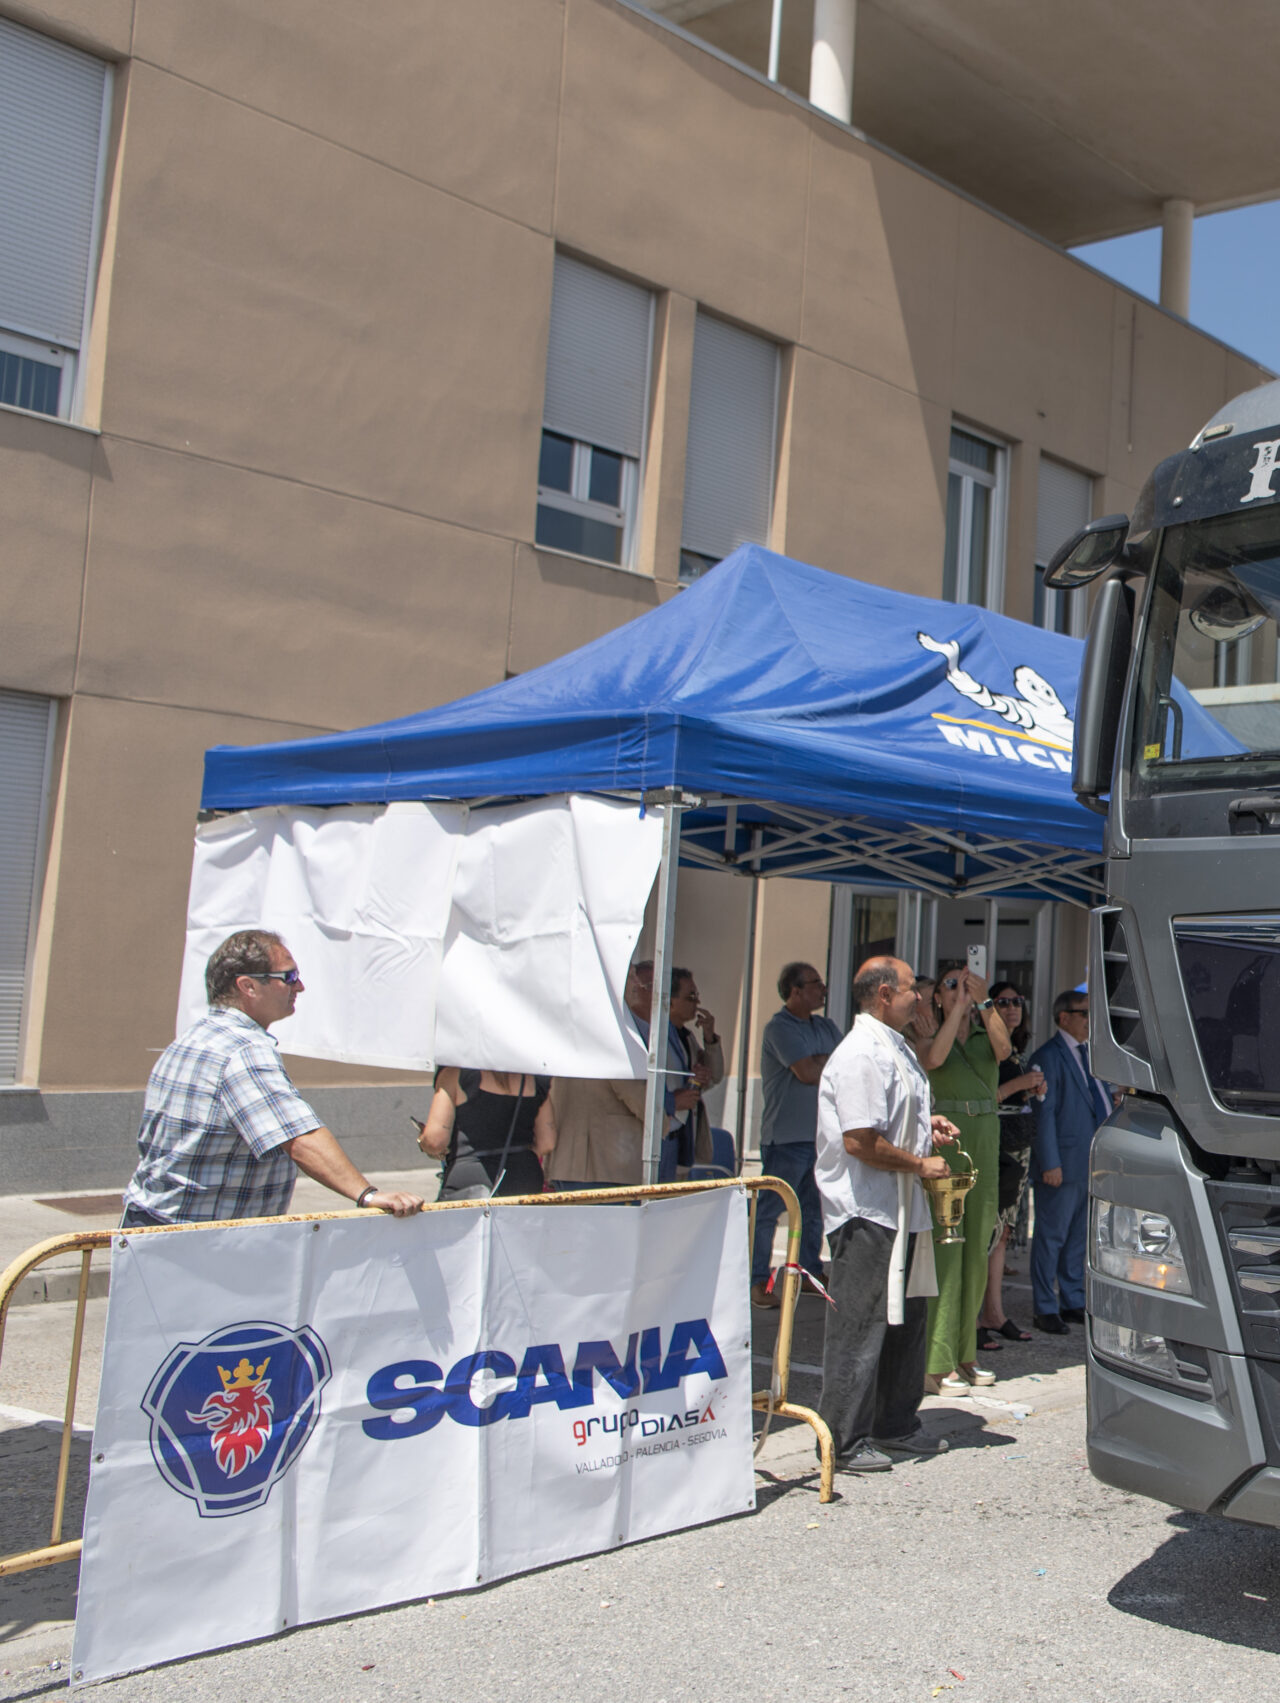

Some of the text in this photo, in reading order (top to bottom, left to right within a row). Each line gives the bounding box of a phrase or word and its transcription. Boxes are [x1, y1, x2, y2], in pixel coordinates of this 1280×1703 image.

[361, 1317, 729, 1441] SCANIA
[573, 1401, 716, 1447] grupo DIASA
[635, 1438, 681, 1458] PALENCIA
[686, 1427, 728, 1447] SEGOVIA
